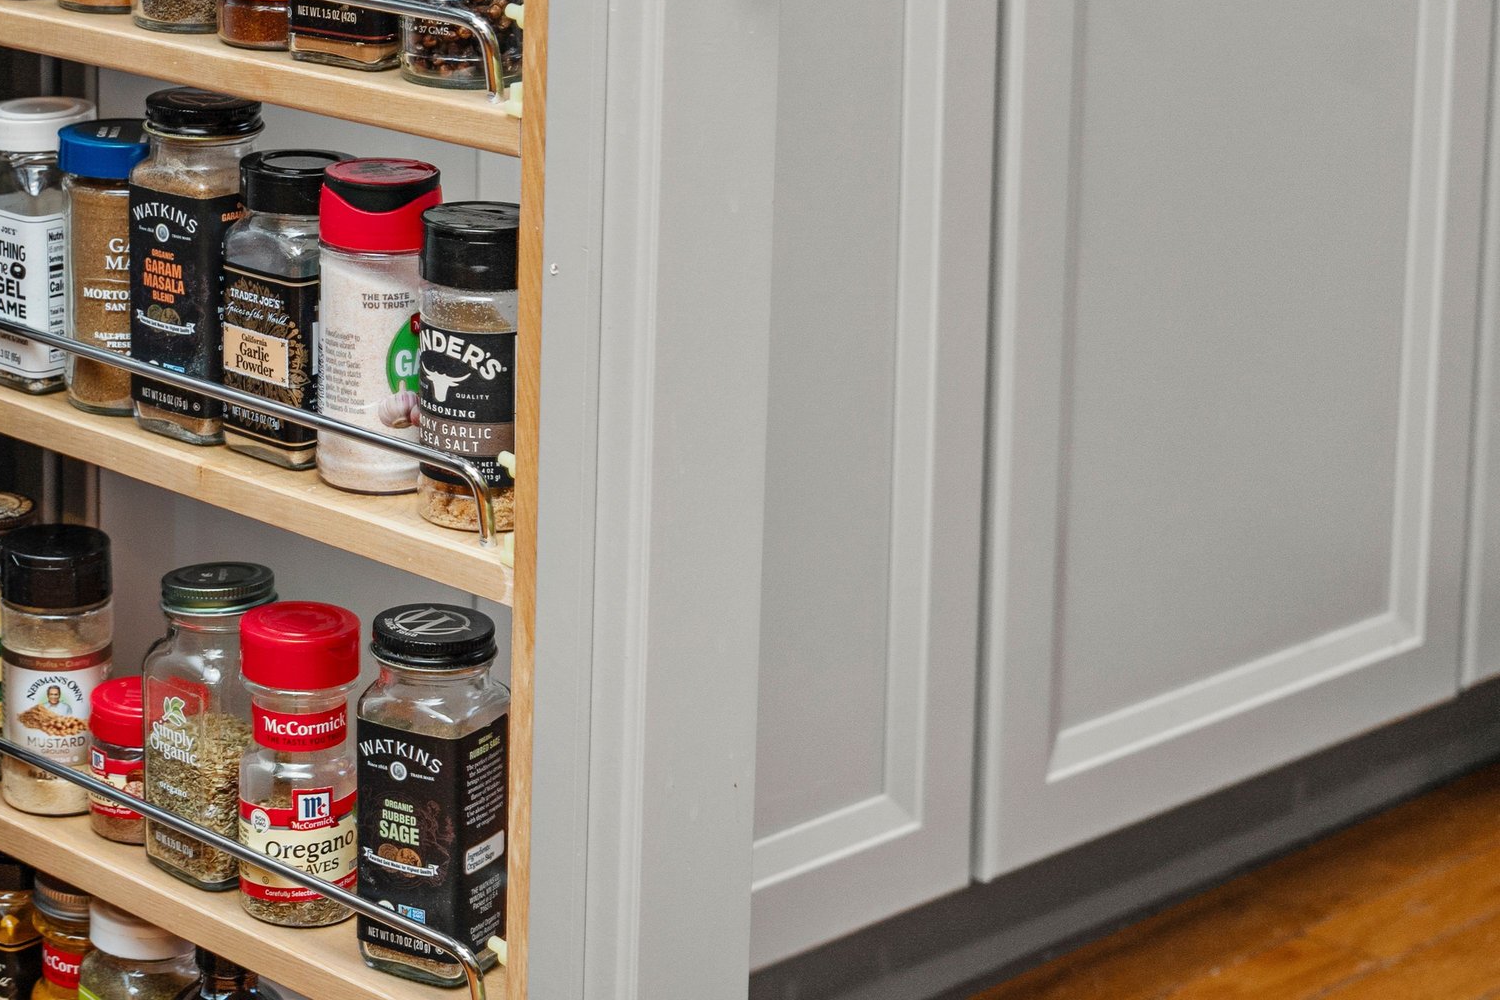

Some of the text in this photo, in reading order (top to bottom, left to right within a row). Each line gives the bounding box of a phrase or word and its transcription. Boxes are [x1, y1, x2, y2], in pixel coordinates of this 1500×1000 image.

[297, 5, 308, 17] NET
[322, 7, 331, 18] 1.5
[332, 9, 340, 19] OZ
[133, 202, 198, 234] WATKINS
[151, 248, 174, 260] ORGANIC
[145, 257, 182, 279] GARAM
[143, 272, 185, 295] MASALA
[84, 287, 130, 300] MORTO
[152, 290, 174, 304] BLEND
[230, 288, 281, 309] TRADER JOE'S
[362, 292, 410, 301] THE TASTE
[105, 303, 126, 312] SAN
[225, 302, 246, 315] Spices
[253, 310, 264, 320] the
[267, 312, 290, 326] World
[362, 301, 380, 309] YOU
[241, 333, 267, 347] California
[239, 341, 270, 362] Garlic
[235, 353, 274, 378] Powder
[142, 387, 150, 399] NET
[151, 390, 159, 400] WT
[167, 394, 173, 404] OZ
[232, 405, 241, 416] NET
[260, 414, 267, 424] OZ
[420, 399, 476, 419] SEASONING
[442, 423, 492, 439] GARLIC
[424, 433, 479, 452] SEA SALT
[26, 676, 81, 701] NEWMAN'S OWN
[263, 713, 345, 736] McCormick
[27, 736, 85, 749] MUSTARD
[152, 721, 194, 751] Simply
[150, 733, 197, 766] Organic
[360, 739, 443, 773] WATKINS
[160, 780, 187, 798] oregano
[385, 798, 413, 813] ORGANIC
[291, 817, 334, 831] McCormick
[382, 808, 416, 826] RUBBED
[380, 820, 420, 846] SAGE
[265, 829, 354, 863] Oregano
[265, 889, 290, 898] Carefully
[368, 926, 379, 937] NET
[380, 930, 389, 938] WT
[404, 934, 412, 947] OZ
